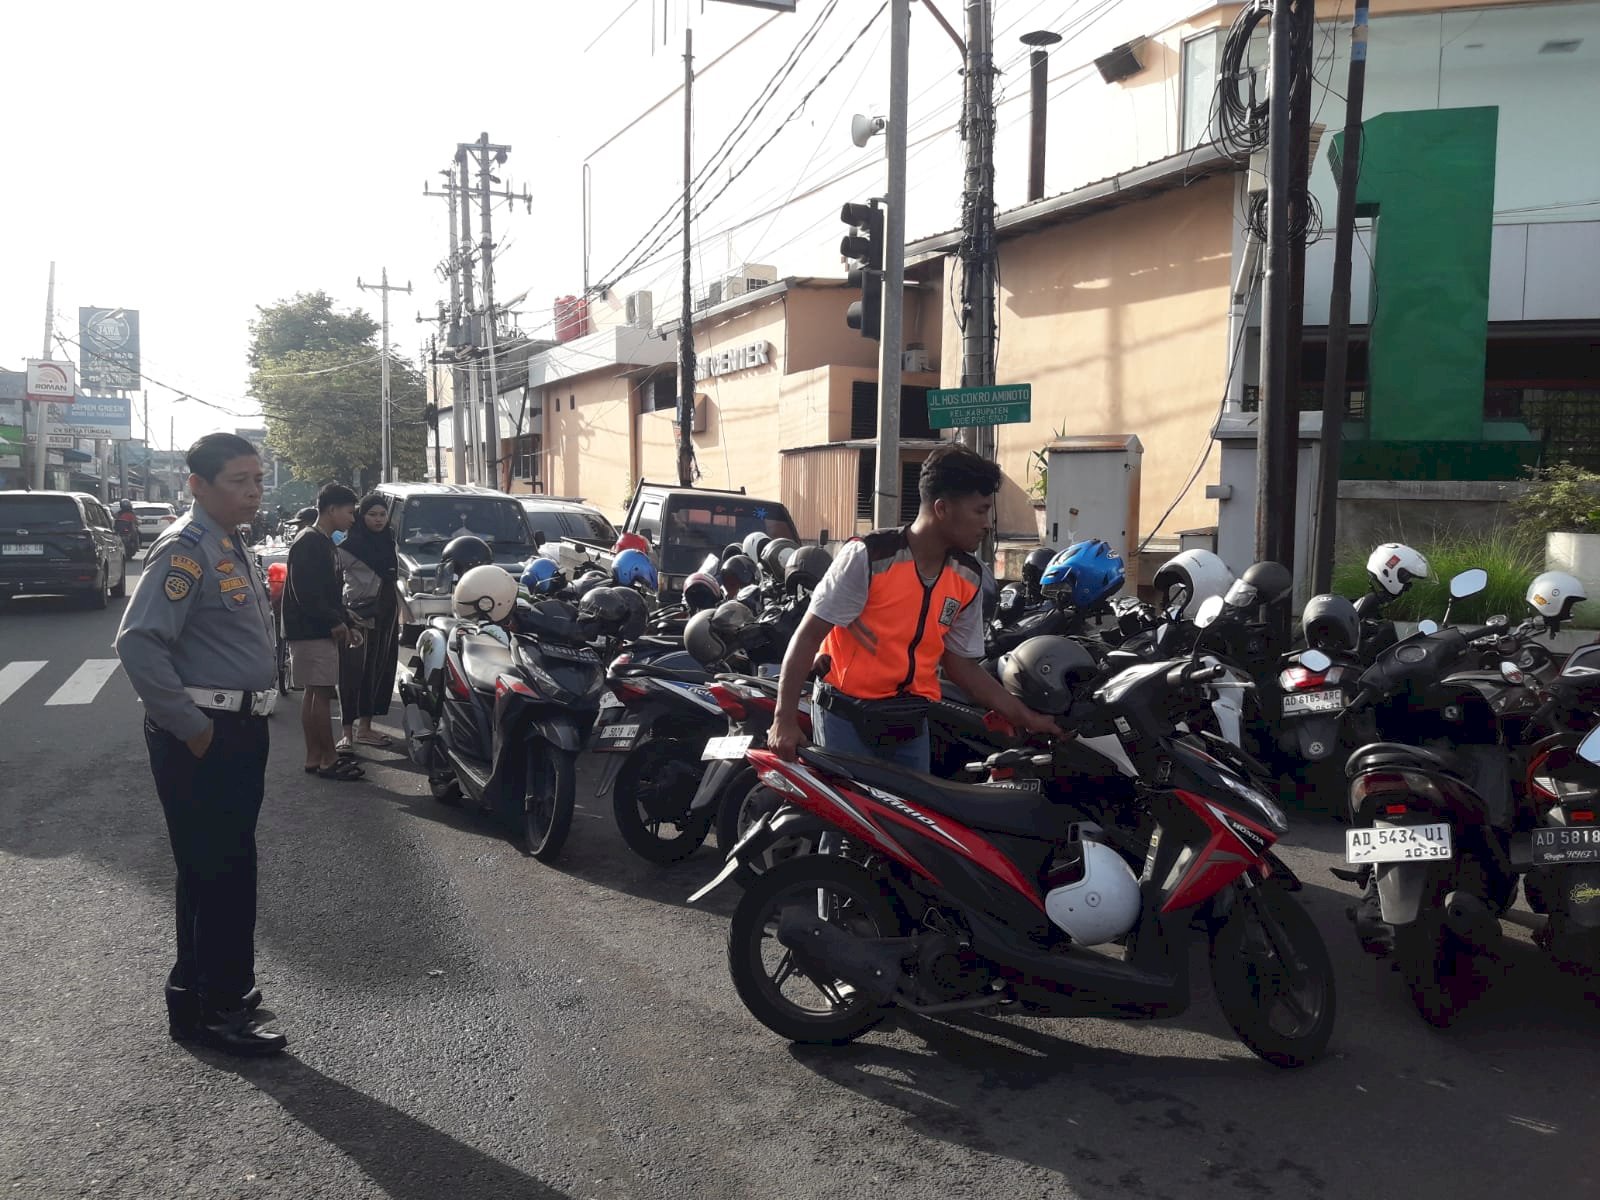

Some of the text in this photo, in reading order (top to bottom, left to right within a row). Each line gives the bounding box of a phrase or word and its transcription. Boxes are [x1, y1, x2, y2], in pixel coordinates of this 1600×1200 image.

[97, 325, 120, 336] JAWA
[710, 339, 769, 377] CENTER
[35, 383, 67, 392] ROMAN
[942, 393, 960, 405] HOS
[961, 391, 990, 404] COKRO
[992, 389, 1029, 402] AMINOTO
[967, 406, 1009, 416] KABUPATEN
[1232, 822, 1264, 846] HONDA
[1352, 827, 1443, 846] AD 5434 UI
[1536, 830, 1600, 846] AD 5818
